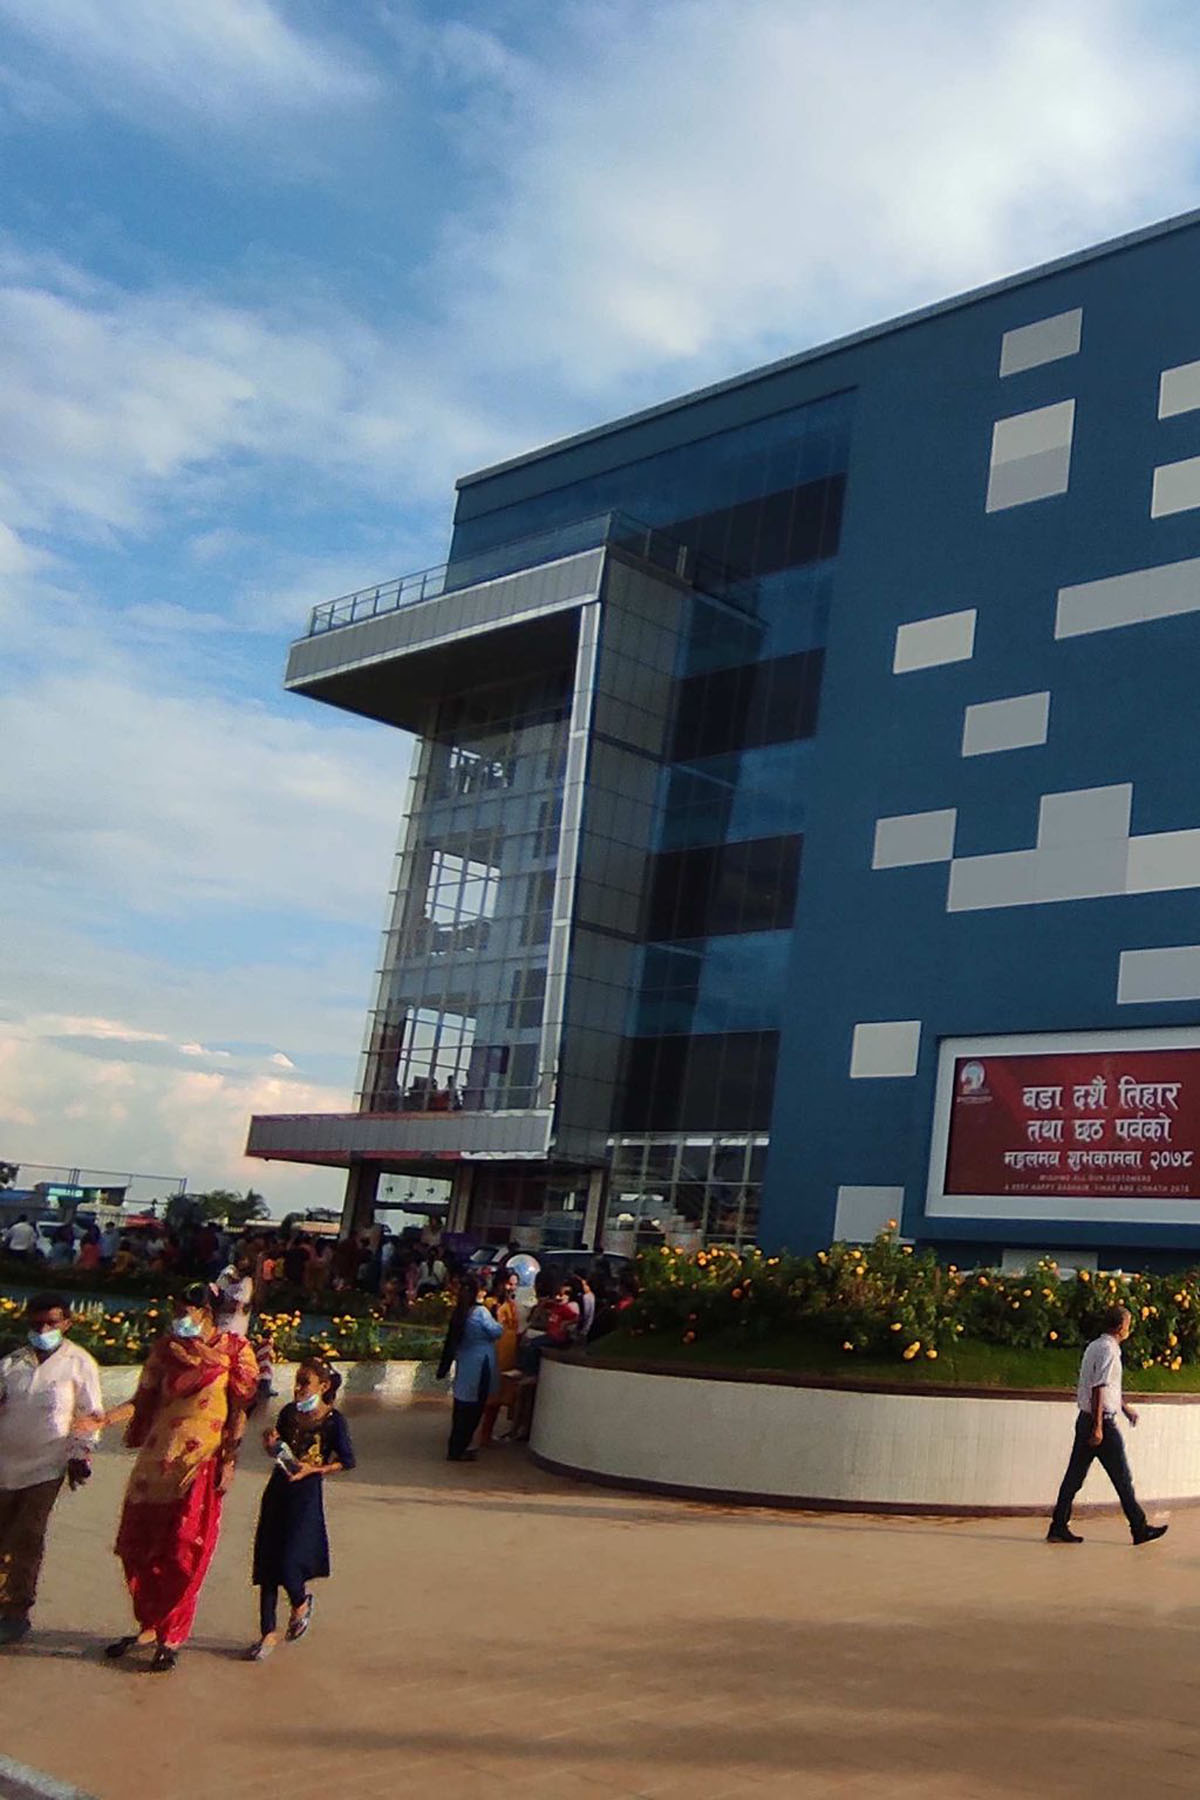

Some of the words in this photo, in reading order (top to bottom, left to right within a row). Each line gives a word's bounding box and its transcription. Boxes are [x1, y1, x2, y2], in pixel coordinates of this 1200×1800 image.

[1022, 1086, 1064, 1110] बडा
[1118, 1075, 1182, 1110] तिहार
[1027, 1119, 1064, 1142] तथा
[1115, 1111, 1172, 1142] पर्वको
[1067, 1151, 1142, 1171] शुभकामना
[1150, 1151, 1194, 1170] २०७८
